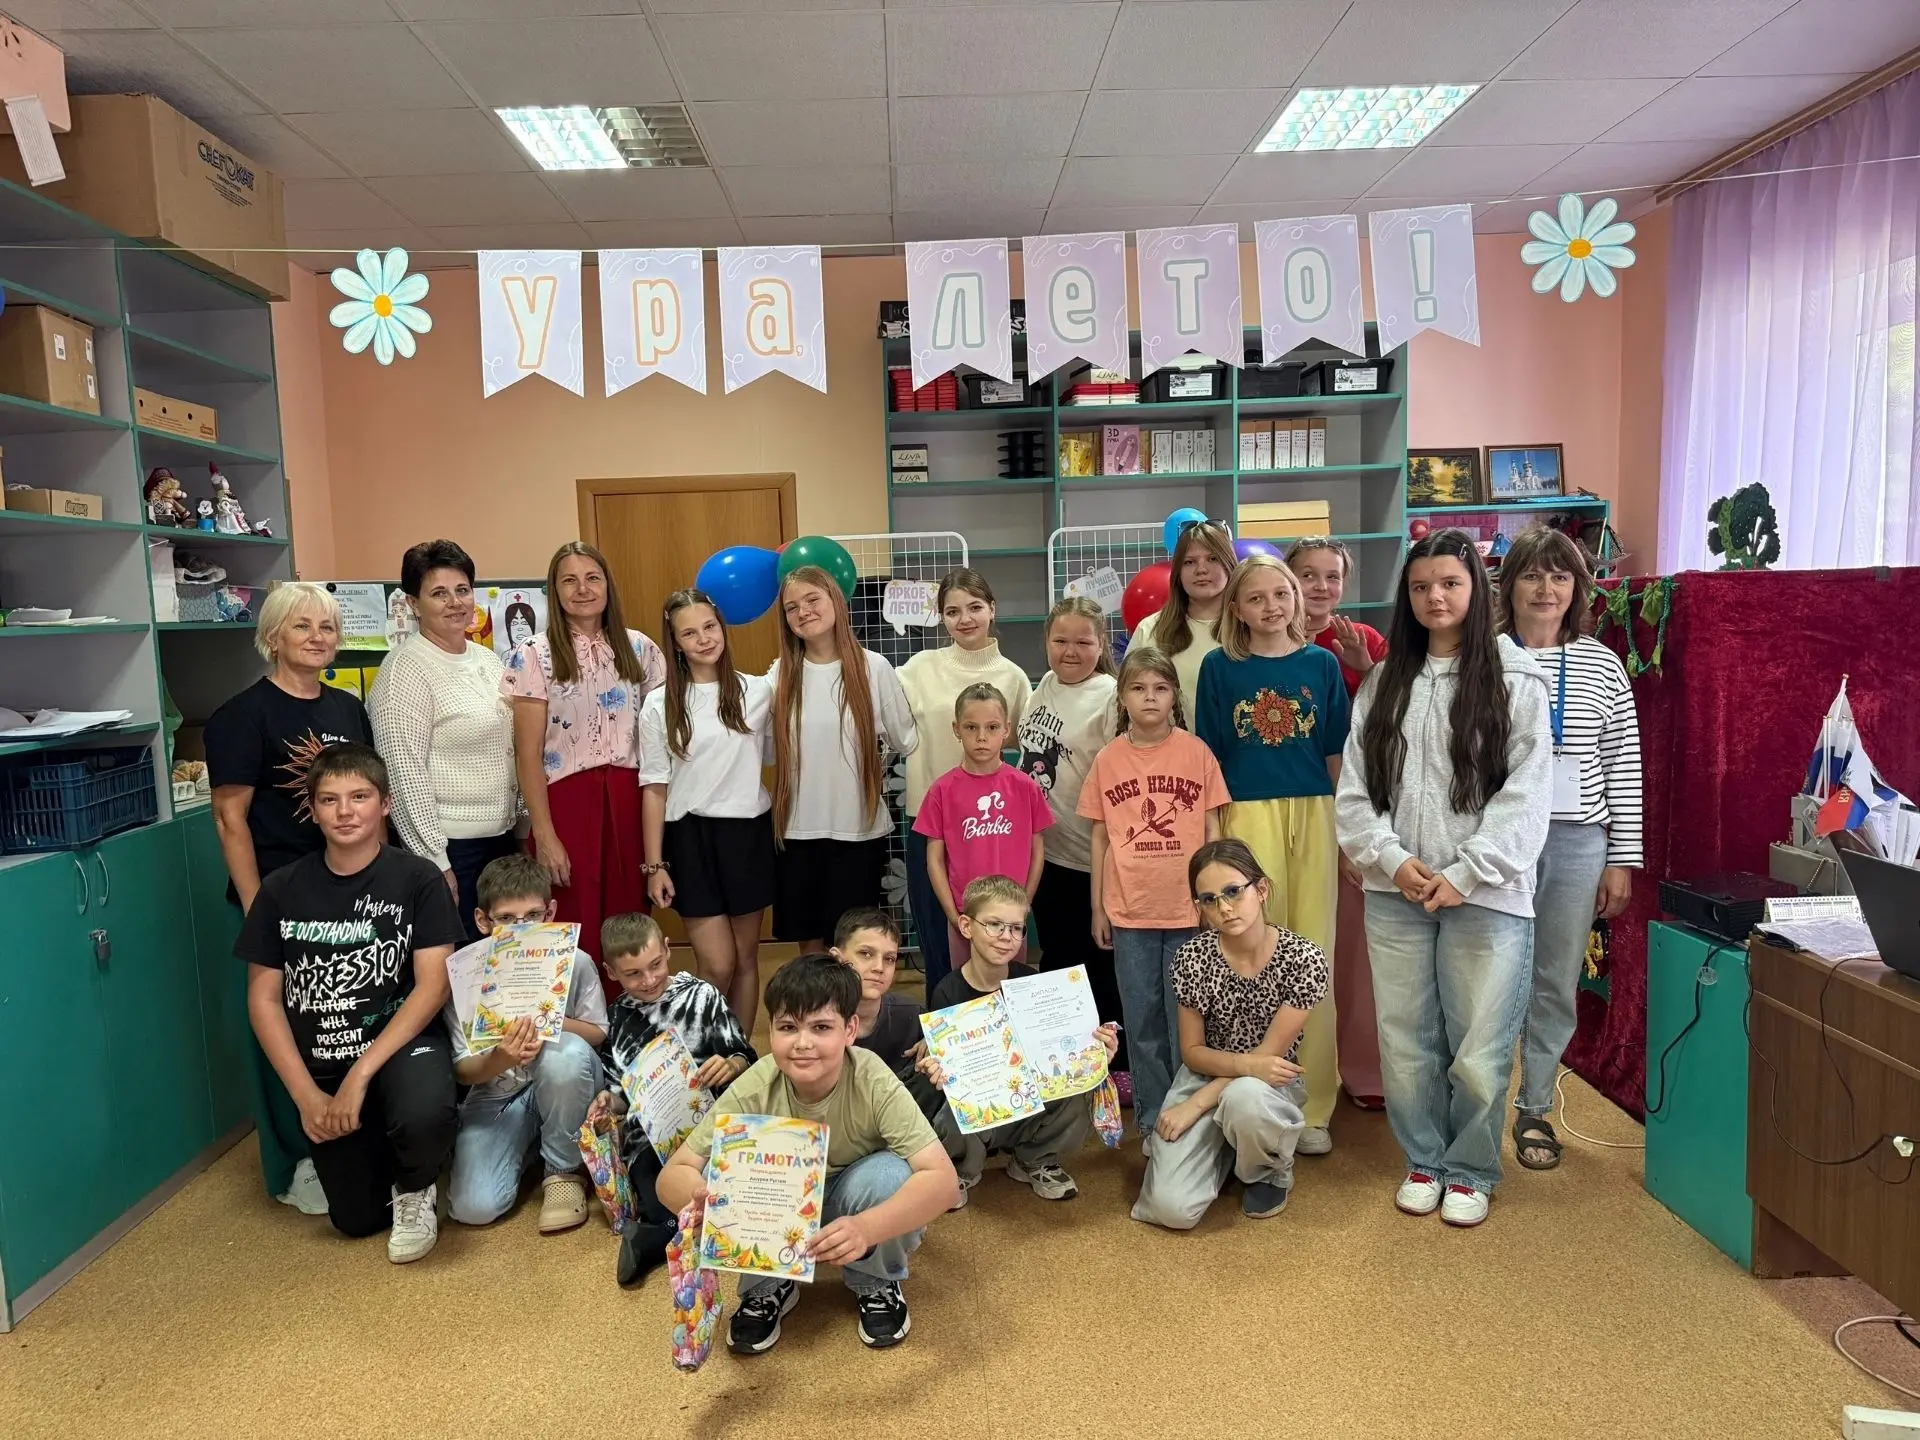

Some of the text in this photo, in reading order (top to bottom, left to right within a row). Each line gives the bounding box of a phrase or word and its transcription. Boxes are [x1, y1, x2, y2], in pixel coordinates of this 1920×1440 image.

[1107, 428, 1120, 437] 3D
[1085, 572, 1116, 591] ЛУЧШЕЕ
[888, 587, 925, 599] ЯРКОЕ
[1097, 583, 1120, 599] ЛЕТО!
[889, 601, 924, 615] ЛЕТО!
[1026, 705, 1064, 736] Main
[1104, 775, 1203, 808] ROSE HEARTS
[962, 815, 1013, 841] Barbie
[1134, 840, 1181, 851] MEMBER CLUB
[354, 894, 404, 925] Mastery
[280, 917, 373, 945] BE OUTSTANDING
[506, 947, 555, 960] ГРАМОТА
[312, 997, 358, 1014] FUTURE
[320, 1014, 350, 1030] WILL
[316, 1028, 364, 1046] PRESENT
[947, 1024, 995, 1046] ГРАМОТА
[311, 1047, 332, 1060] NEW
[638, 1059, 673, 1096] ГРАМОТА
[738, 1151, 801, 1168] ГРАМОТА
